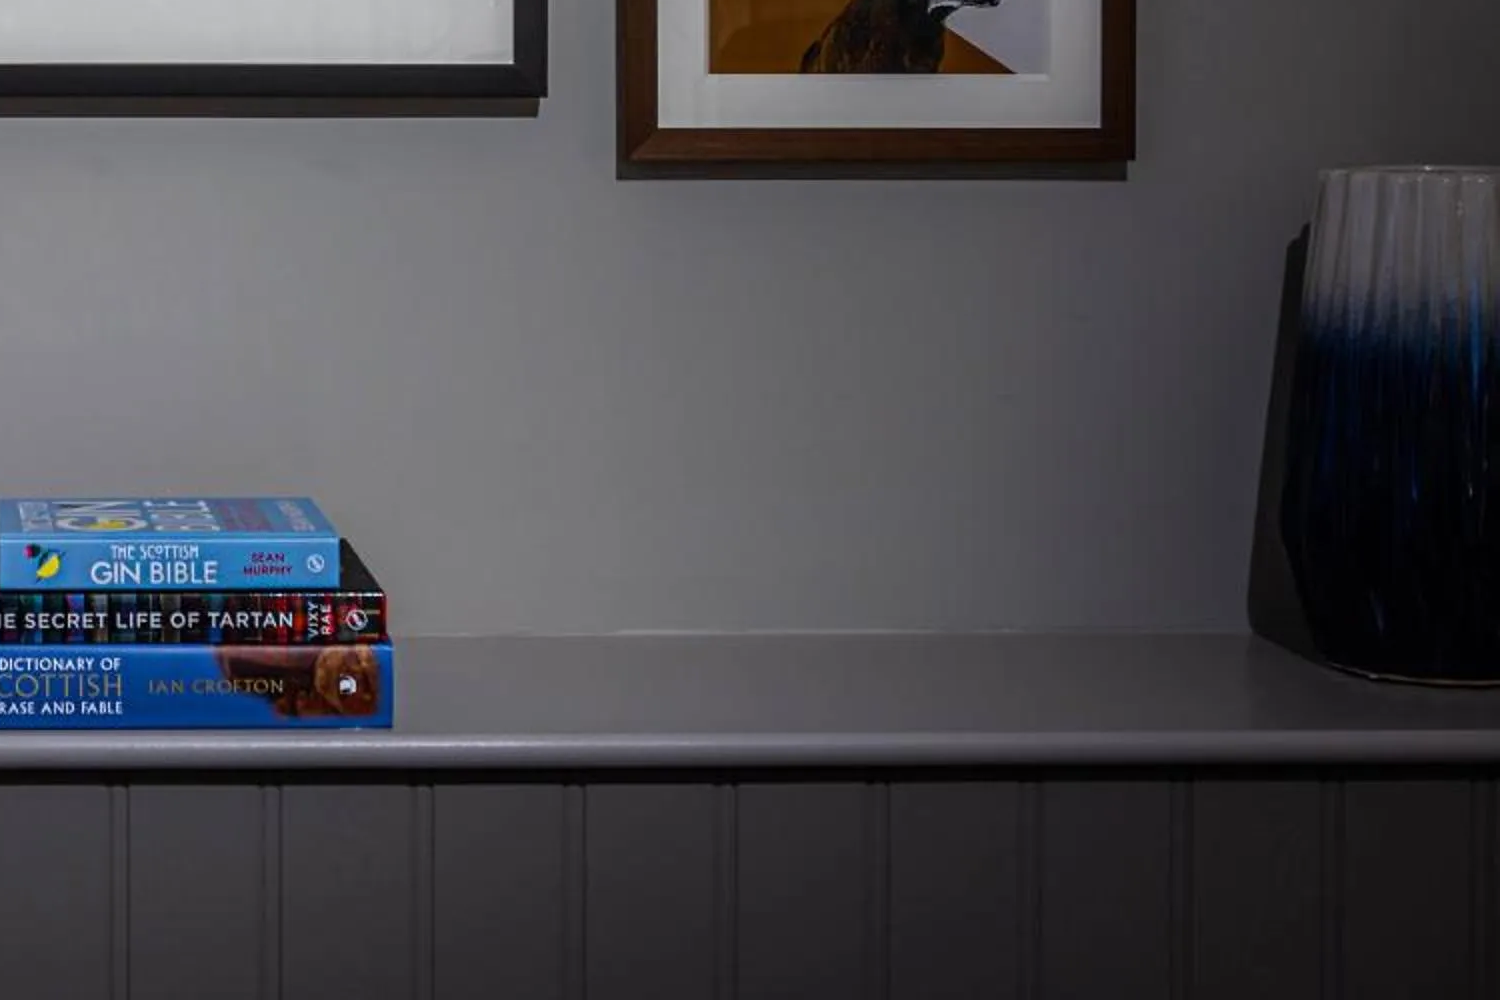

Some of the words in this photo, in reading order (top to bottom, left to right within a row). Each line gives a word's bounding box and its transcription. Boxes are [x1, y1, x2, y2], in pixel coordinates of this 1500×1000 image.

[110, 544, 136, 560] THE
[140, 544, 199, 560] SCOTTISH
[251, 552, 285, 563] SEAN
[90, 560, 141, 585] GIN
[150, 560, 219, 585] BIBLE
[243, 565, 293, 576] MURPHY
[24, 612, 109, 630] SECRET
[115, 611, 163, 630] LIFE
[169, 611, 201, 629] OF
[207, 611, 293, 629] TARTAN
[307, 601, 319, 640] VIXY
[320, 603, 333, 635] RAE
[0, 657, 95, 672] DICTIONARY
[100, 657, 122, 672] OF
[148, 679, 185, 694] IAN
[191, 679, 285, 695] CROFTON
[41, 701, 75, 715] AND
[81, 701, 123, 715] FABLE
